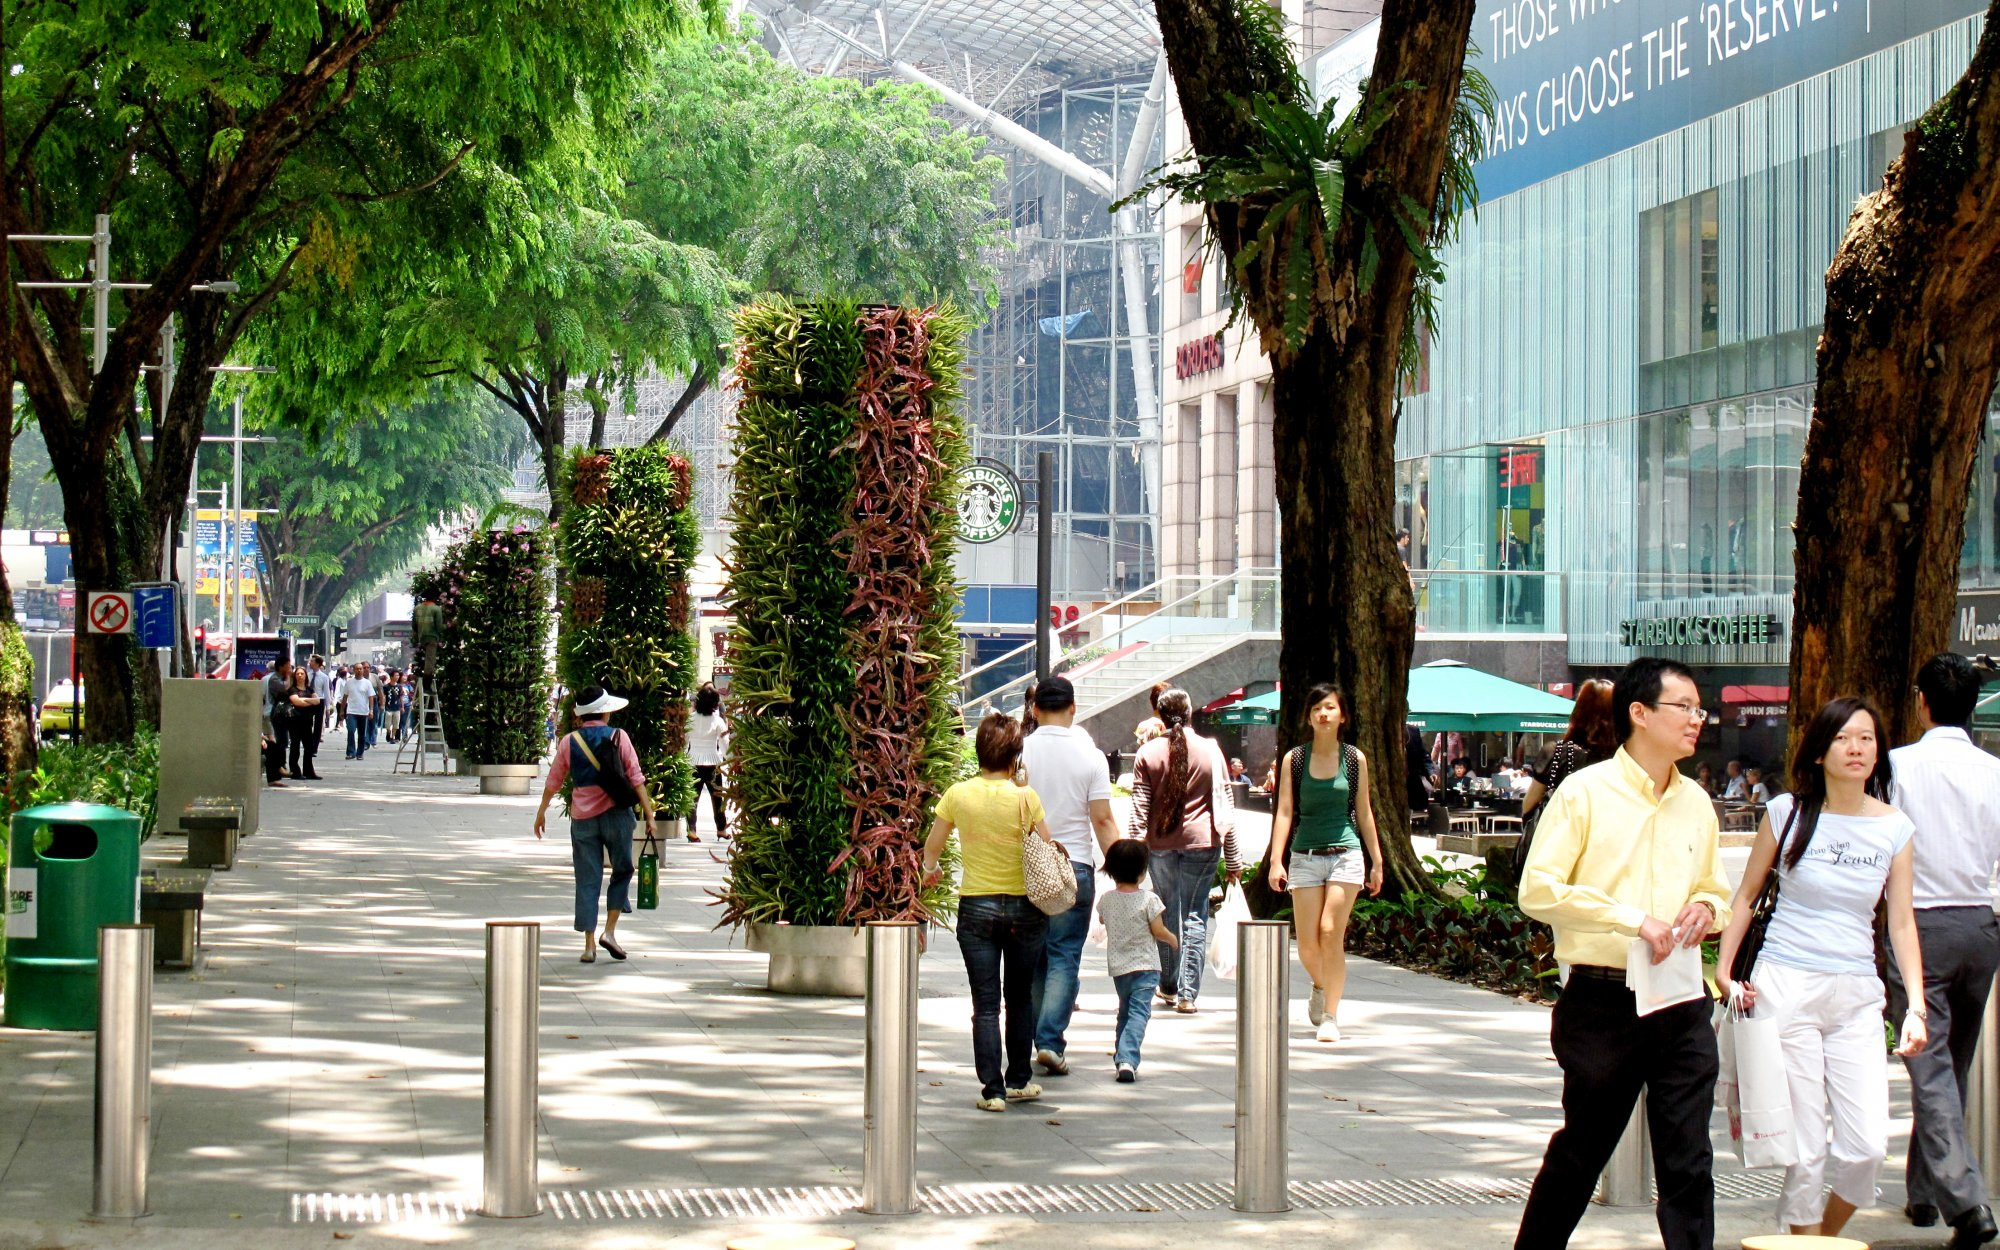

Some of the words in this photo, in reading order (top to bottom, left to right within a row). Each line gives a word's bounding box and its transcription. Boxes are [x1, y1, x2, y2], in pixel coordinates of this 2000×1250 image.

[1489, 0, 1559, 63] THOSE
[1465, 91, 1528, 166] WAYS
[1536, 42, 1634, 136] CHOOSE
[1642, 16, 1689, 91] THE
[1176, 334, 1220, 380] BORDERS
[956, 469, 1013, 503] RBUCKS
[1620, 617, 1702, 646] STARBUCKS
[1708, 614, 1769, 645] COFFEE
